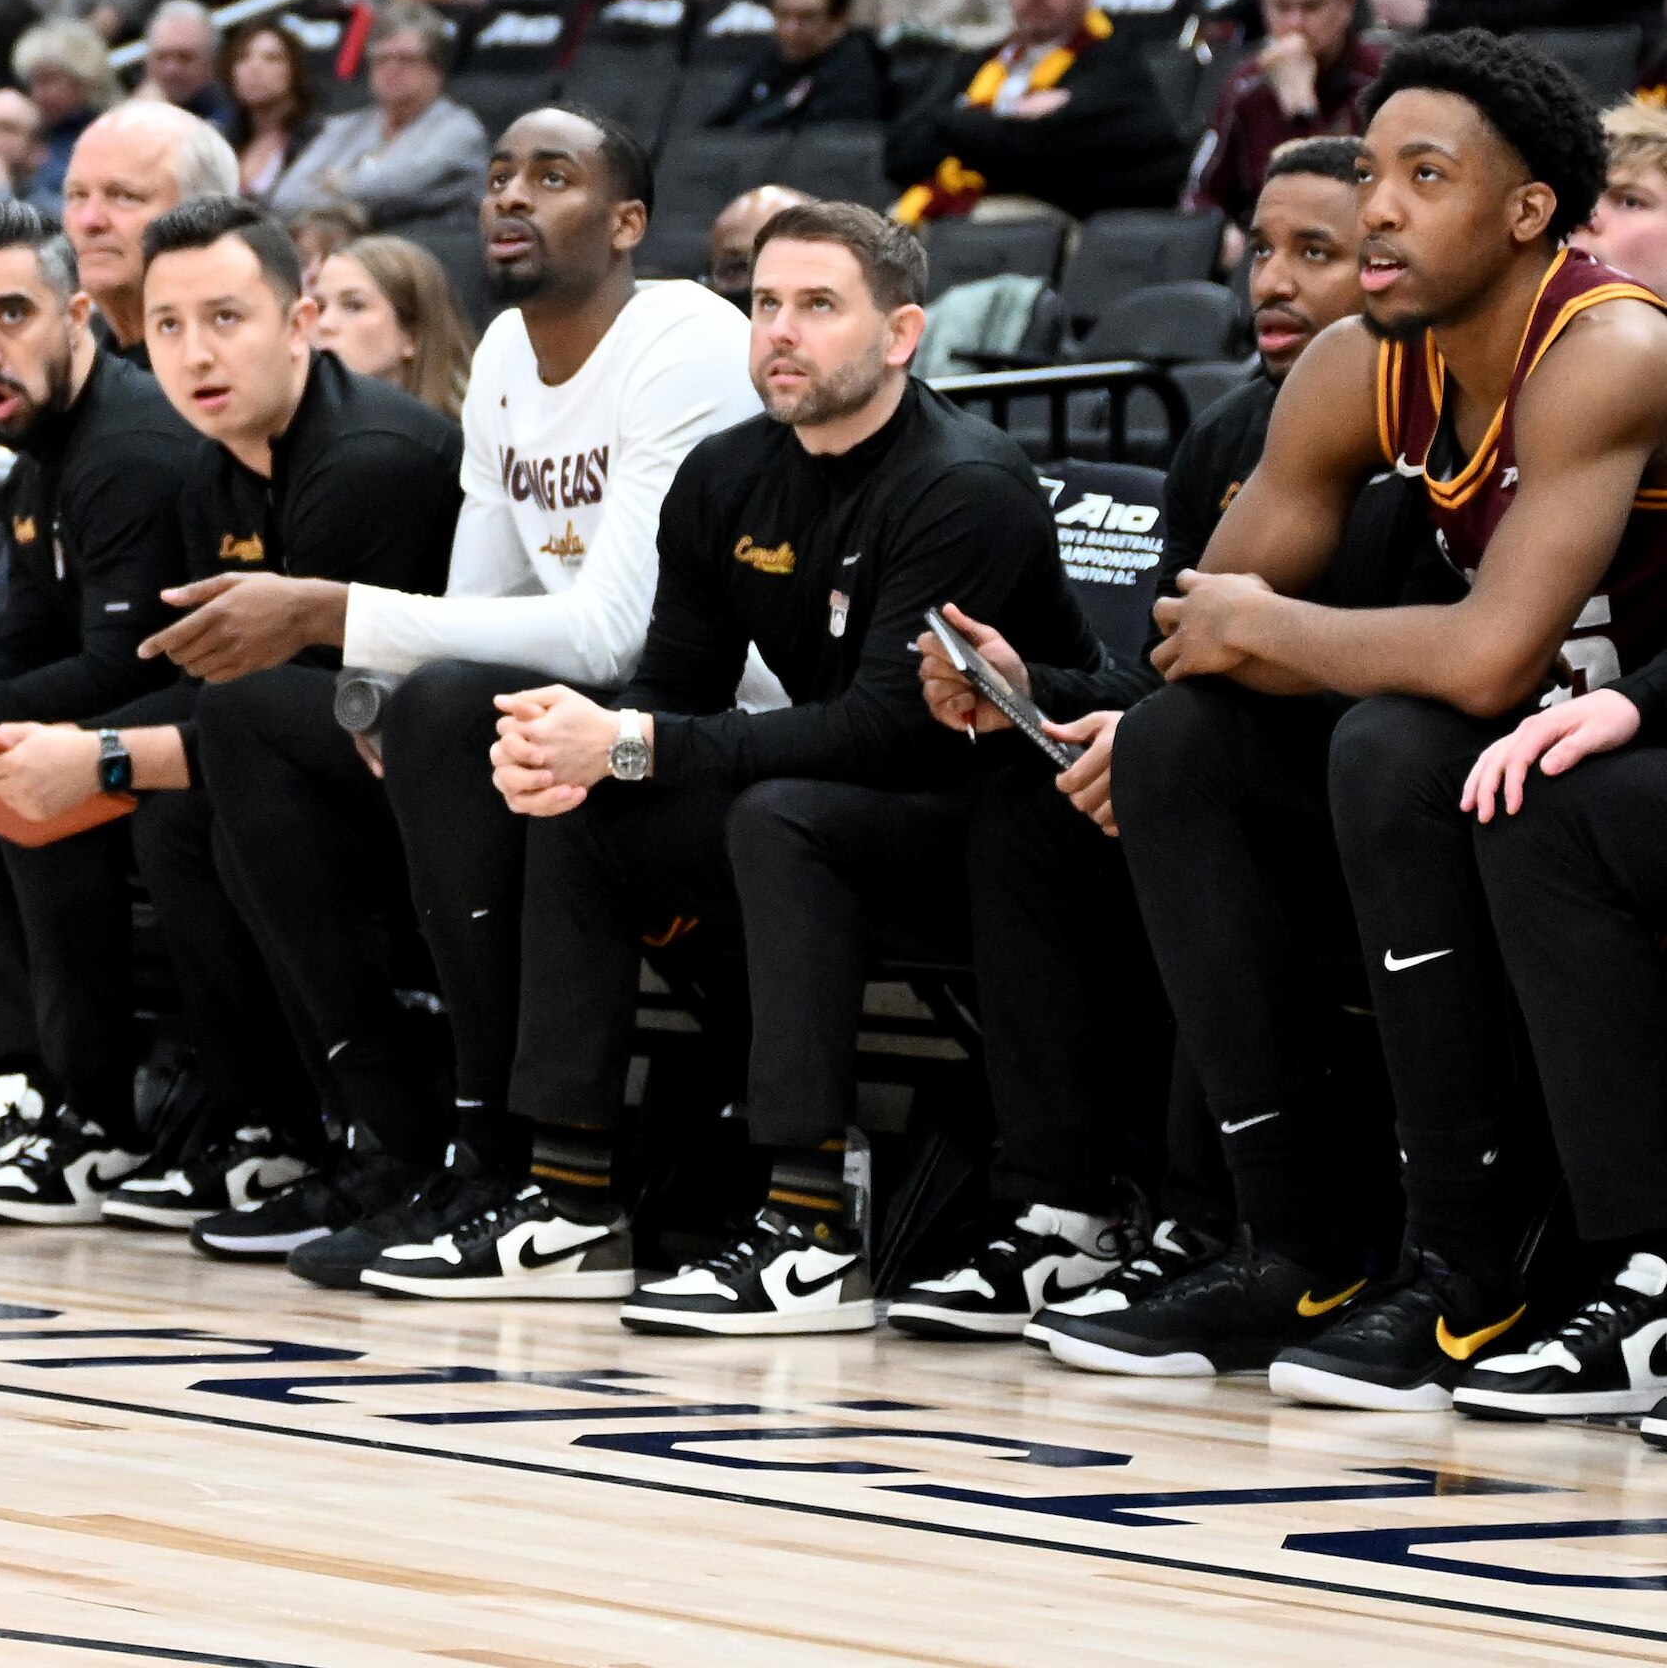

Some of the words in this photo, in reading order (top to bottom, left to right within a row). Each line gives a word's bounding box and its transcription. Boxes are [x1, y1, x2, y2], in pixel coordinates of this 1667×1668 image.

[560, 444, 610, 509] EASY
[1054, 492, 1161, 533] A10
[1086, 531, 1164, 553] BASKETBALL
